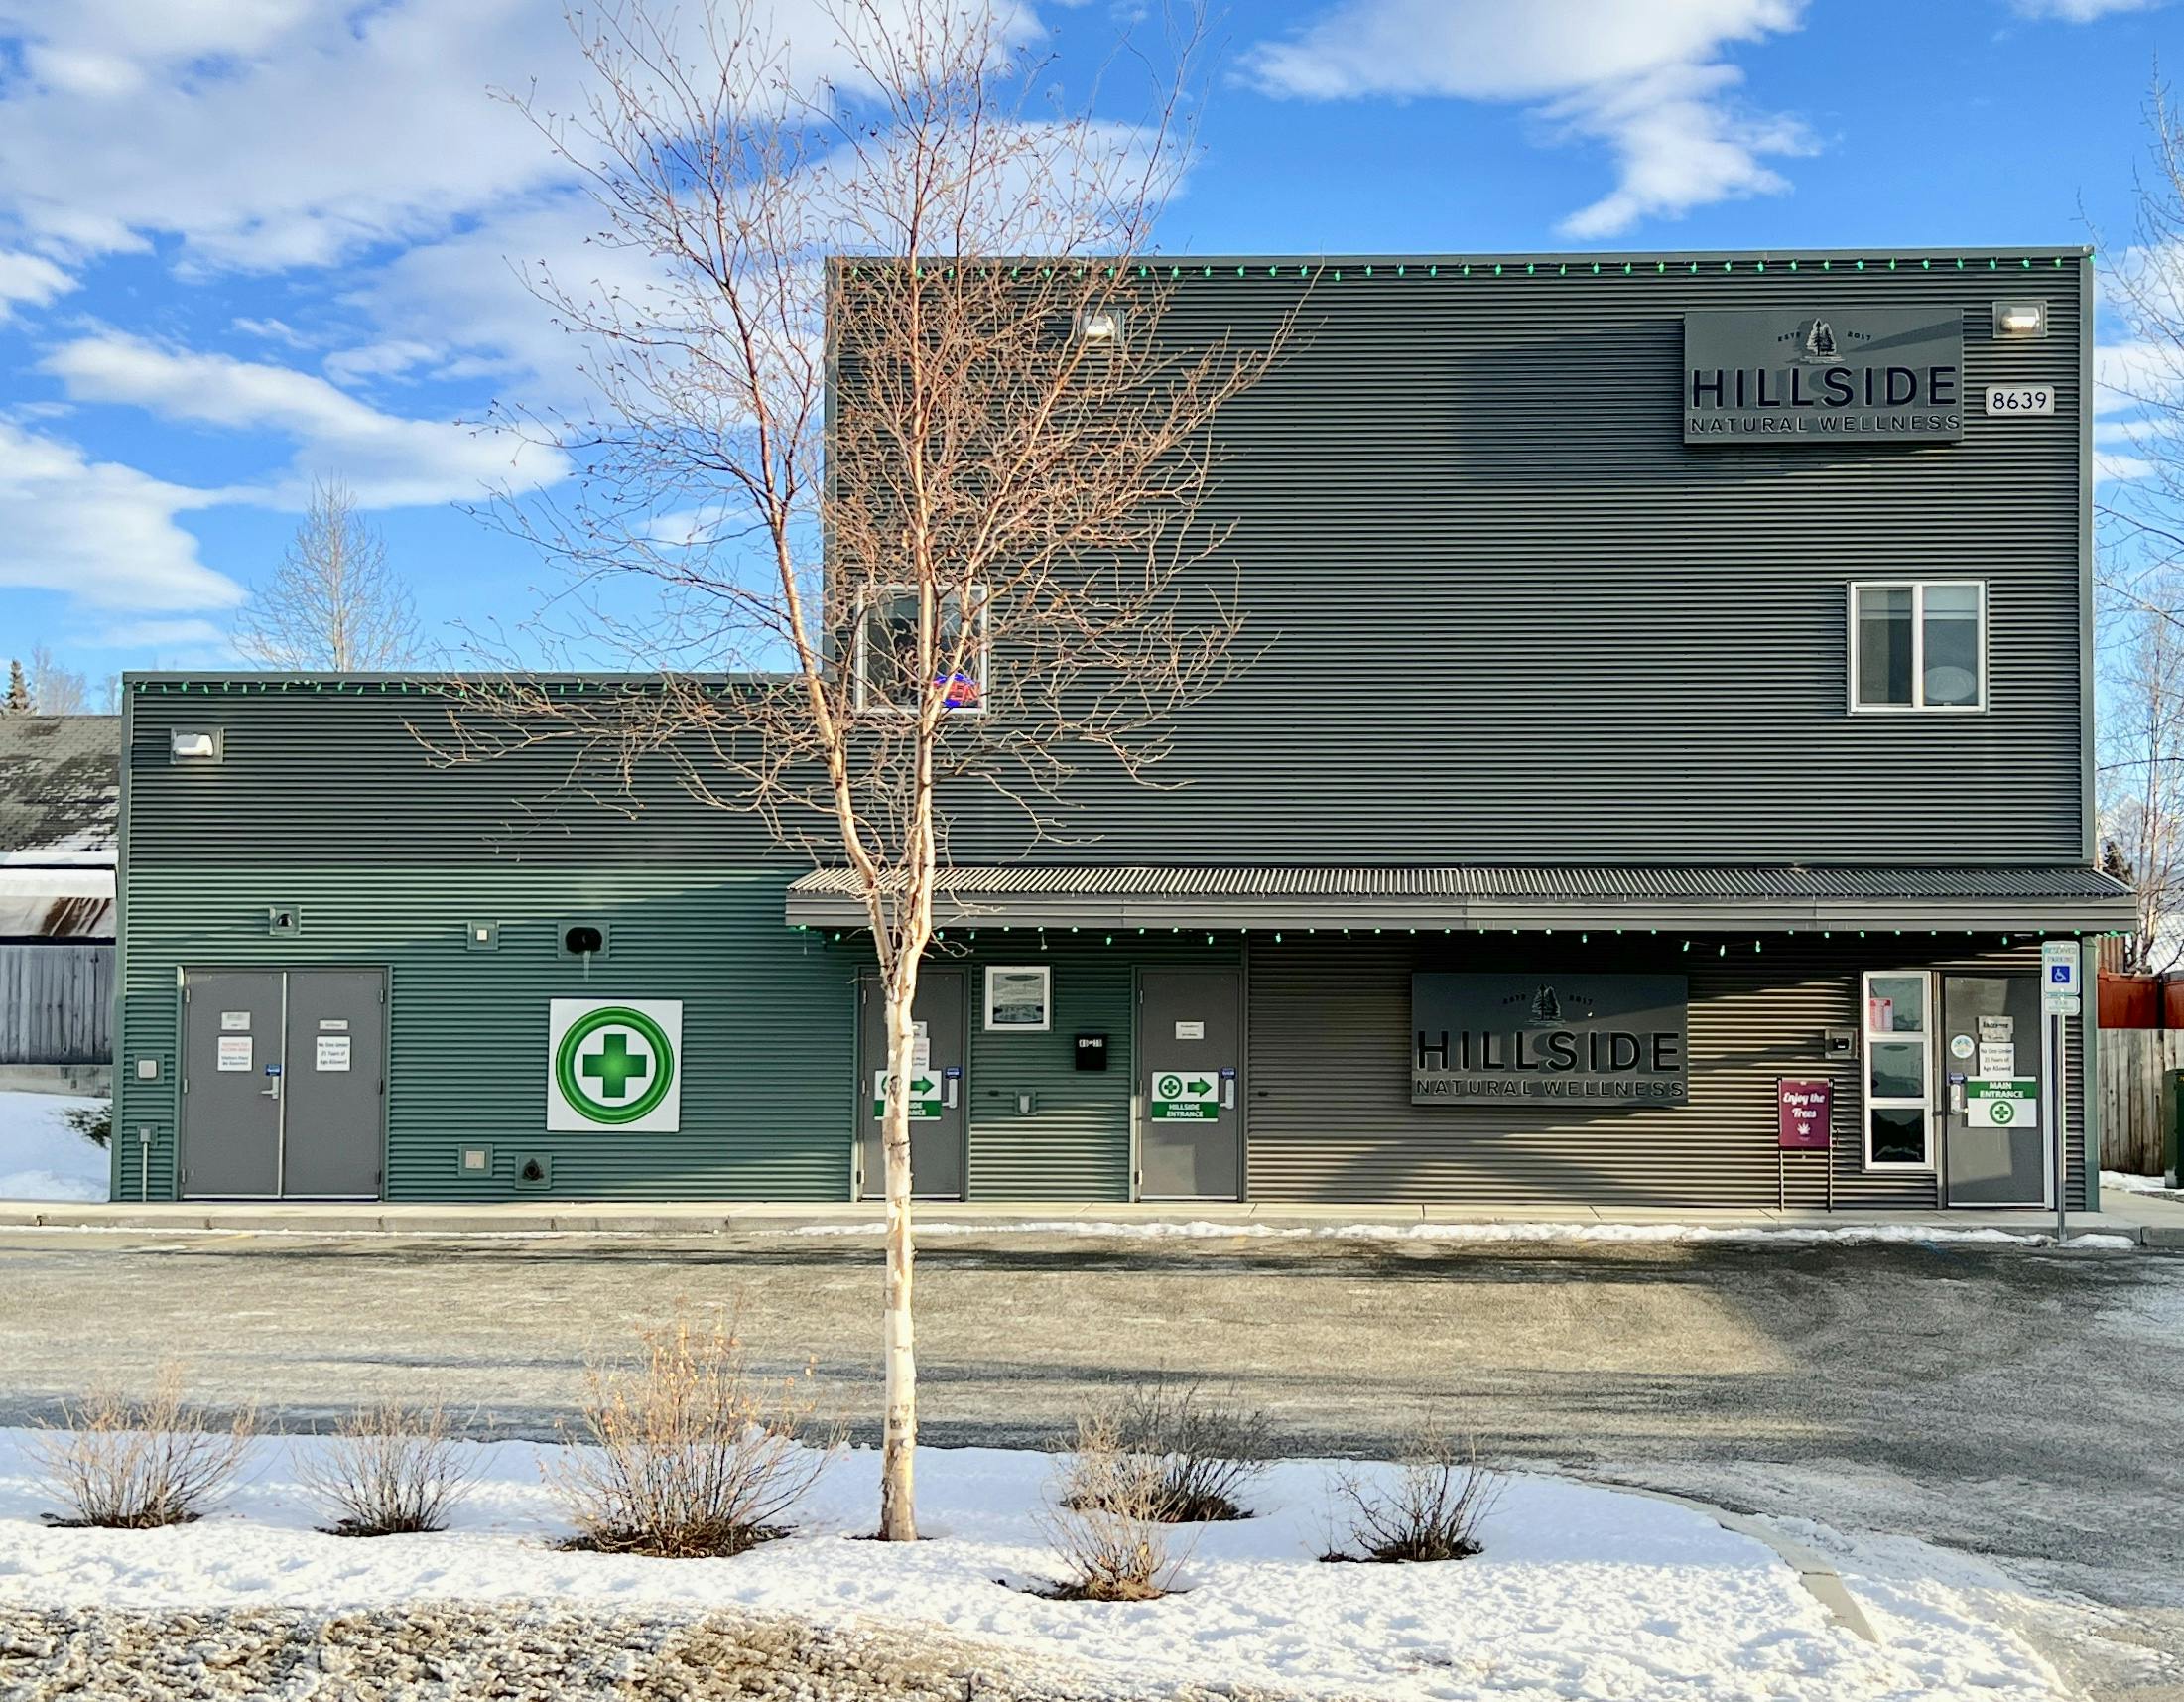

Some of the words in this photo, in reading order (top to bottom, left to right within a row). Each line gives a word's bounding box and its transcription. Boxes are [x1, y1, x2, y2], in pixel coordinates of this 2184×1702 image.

[1847, 330, 1871, 341] 2017
[1691, 366, 1957, 409] HILLSIDE
[1992, 392, 2047, 411] 8639
[1690, 417, 1808, 434] NATURAL
[1819, 415, 1961, 433] WELLNESS
[1417, 1030, 1681, 1071] HILLSIDE
[1416, 1080, 1533, 1096] NATURAL
[1543, 1080, 1684, 1097] WELLNESS
[1989, 1081, 2012, 1090] MAIN
[1783, 1092, 1809, 1106] Enjoy
[1810, 1092, 1825, 1103] the
[1980, 1090, 2024, 1099] ENTRANCE
[1792, 1108, 1817, 1118] Trees
